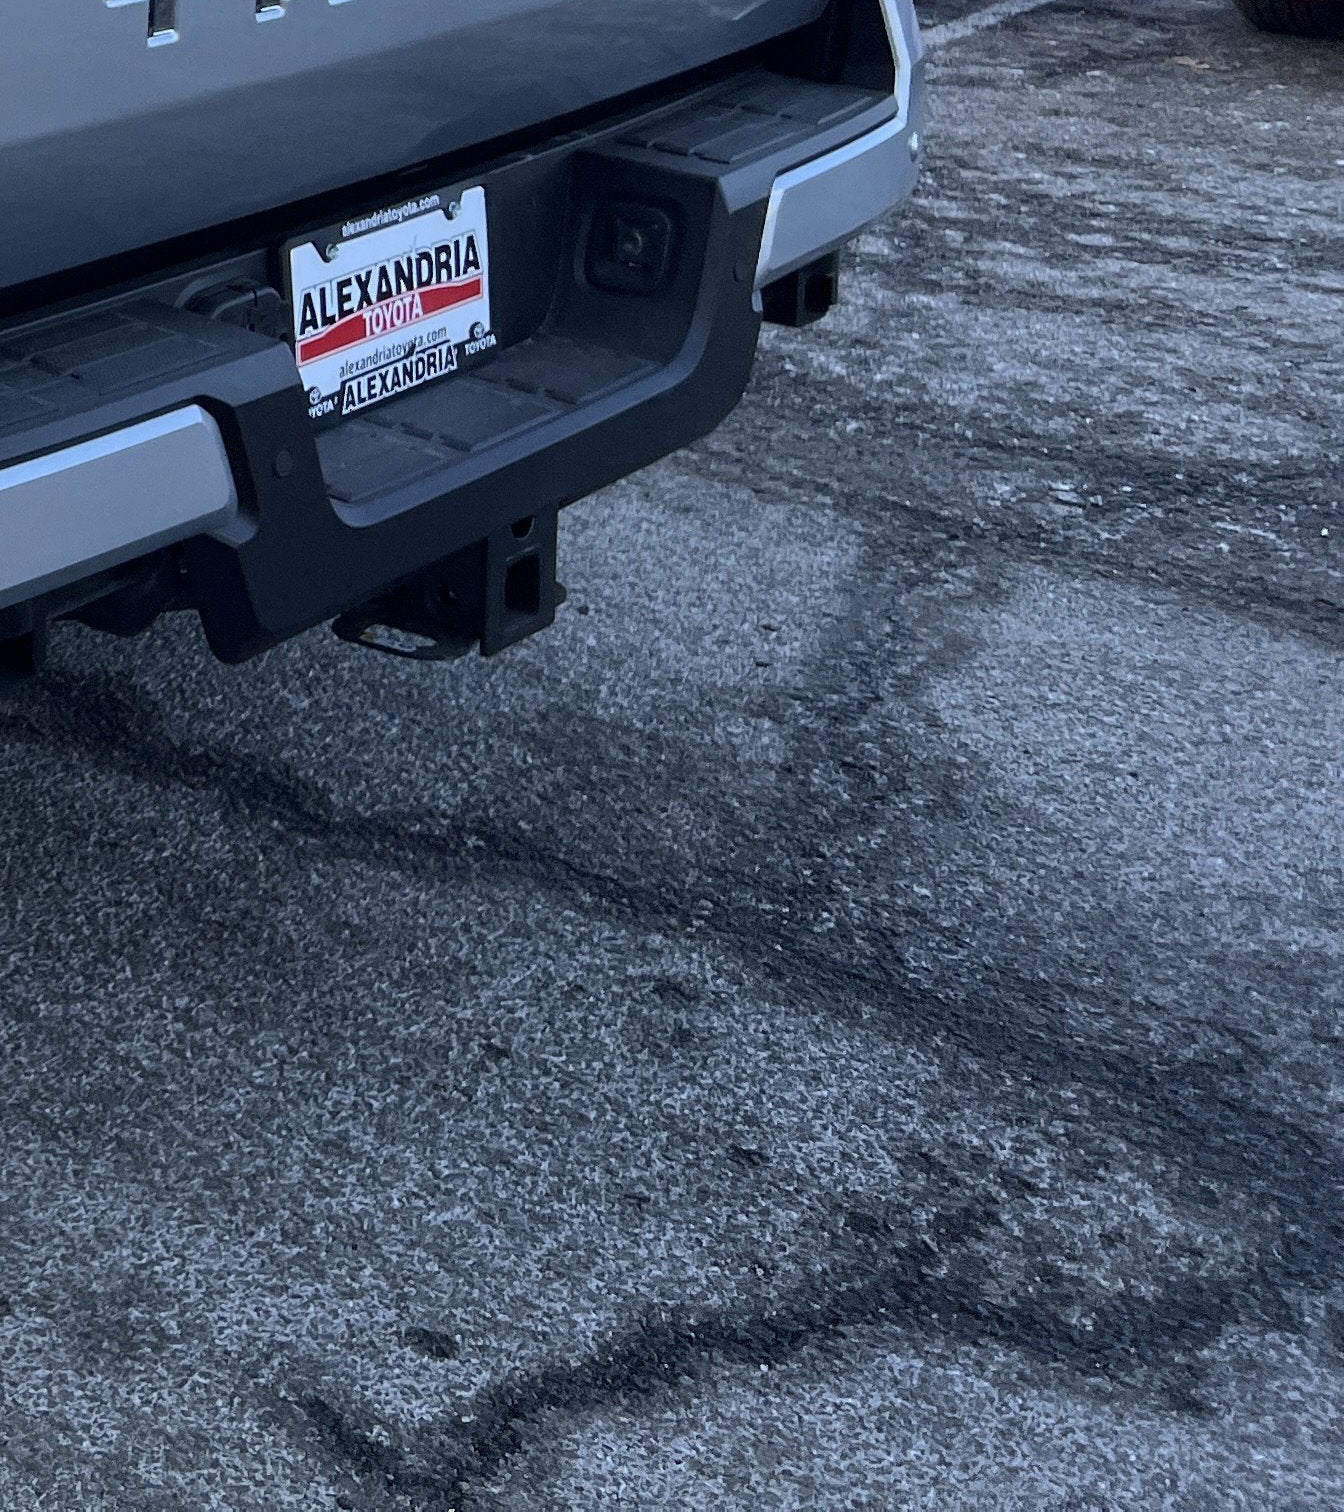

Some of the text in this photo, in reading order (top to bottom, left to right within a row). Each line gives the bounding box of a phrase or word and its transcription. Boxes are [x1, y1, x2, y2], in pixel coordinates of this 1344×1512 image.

[299, 235, 481, 336] ALEXANDRIA
[362, 294, 424, 336] TOYOTA
[464, 334, 497, 356] TOYOTA
[344, 346, 456, 410] ALEXANDRIA
